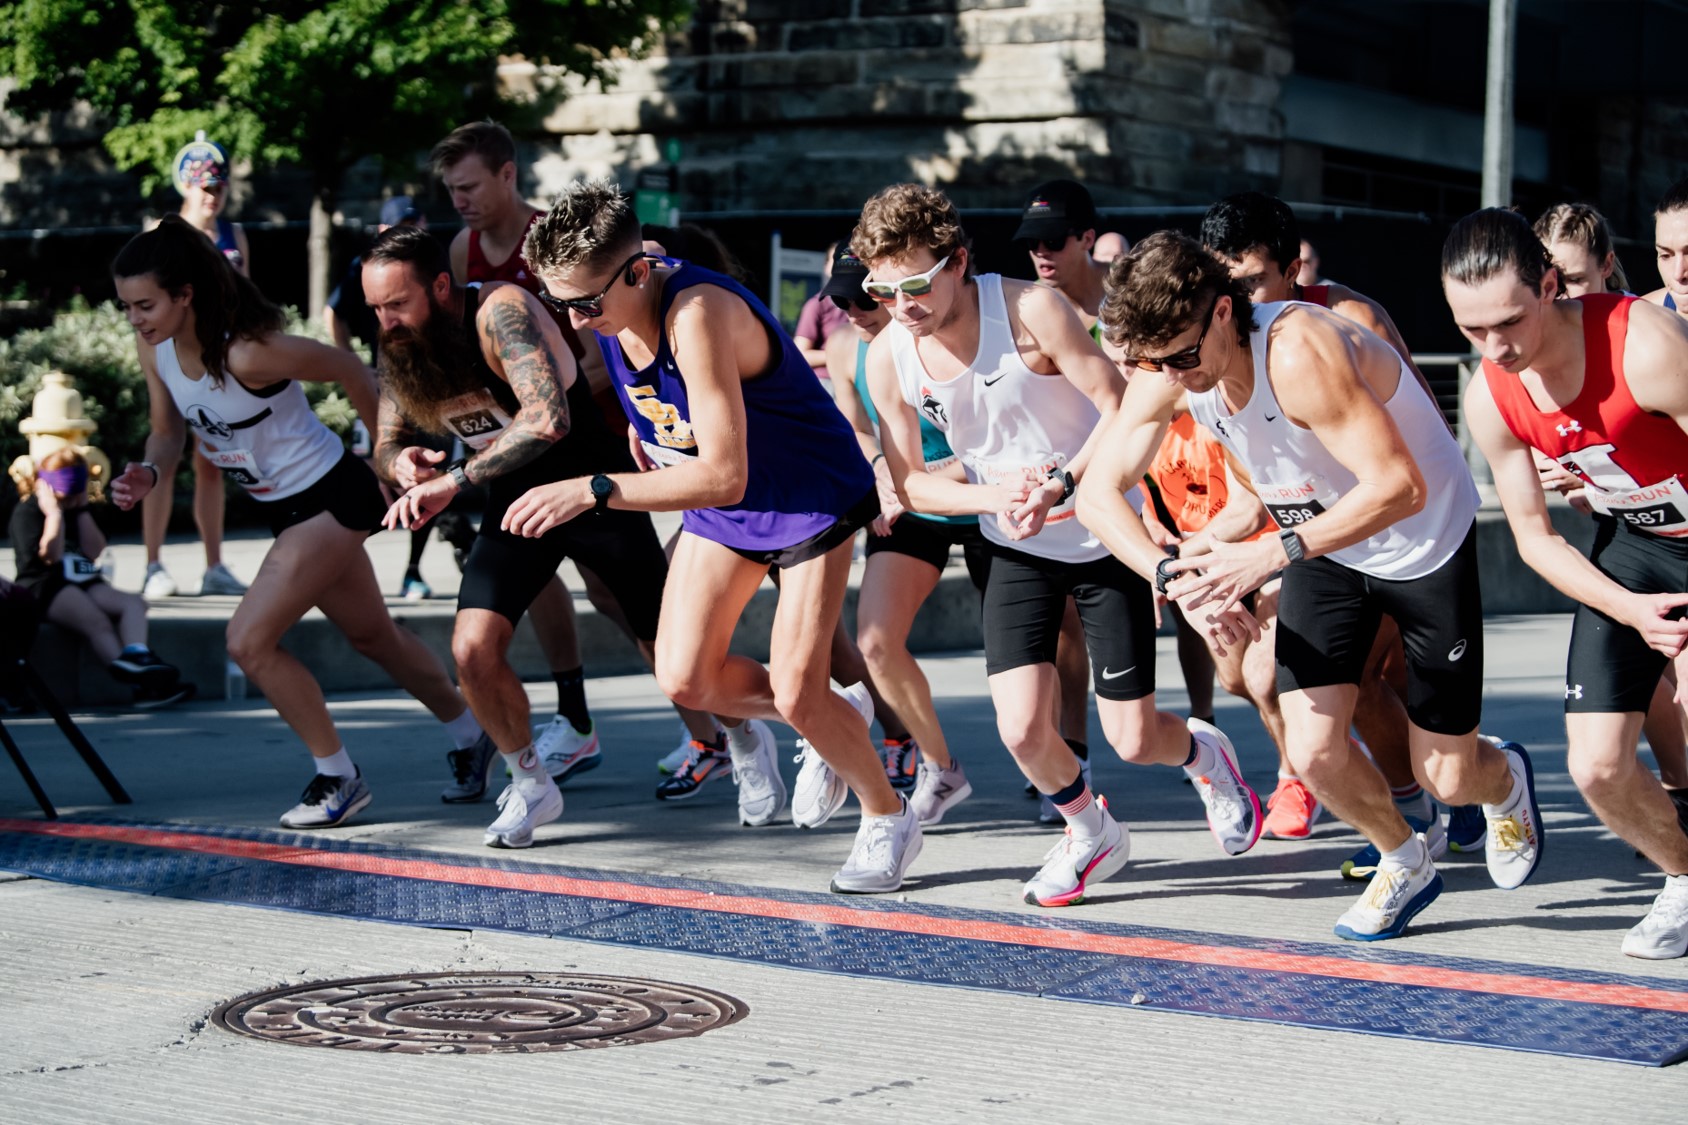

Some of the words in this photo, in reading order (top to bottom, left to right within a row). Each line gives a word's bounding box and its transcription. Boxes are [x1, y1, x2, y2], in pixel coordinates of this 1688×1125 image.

[460, 416, 492, 433] 624
[220, 453, 247, 464] RUN
[1278, 482, 1315, 499] RUN
[1629, 485, 1672, 504] RUN
[1276, 508, 1315, 525] 598
[1623, 509, 1665, 525] 587
